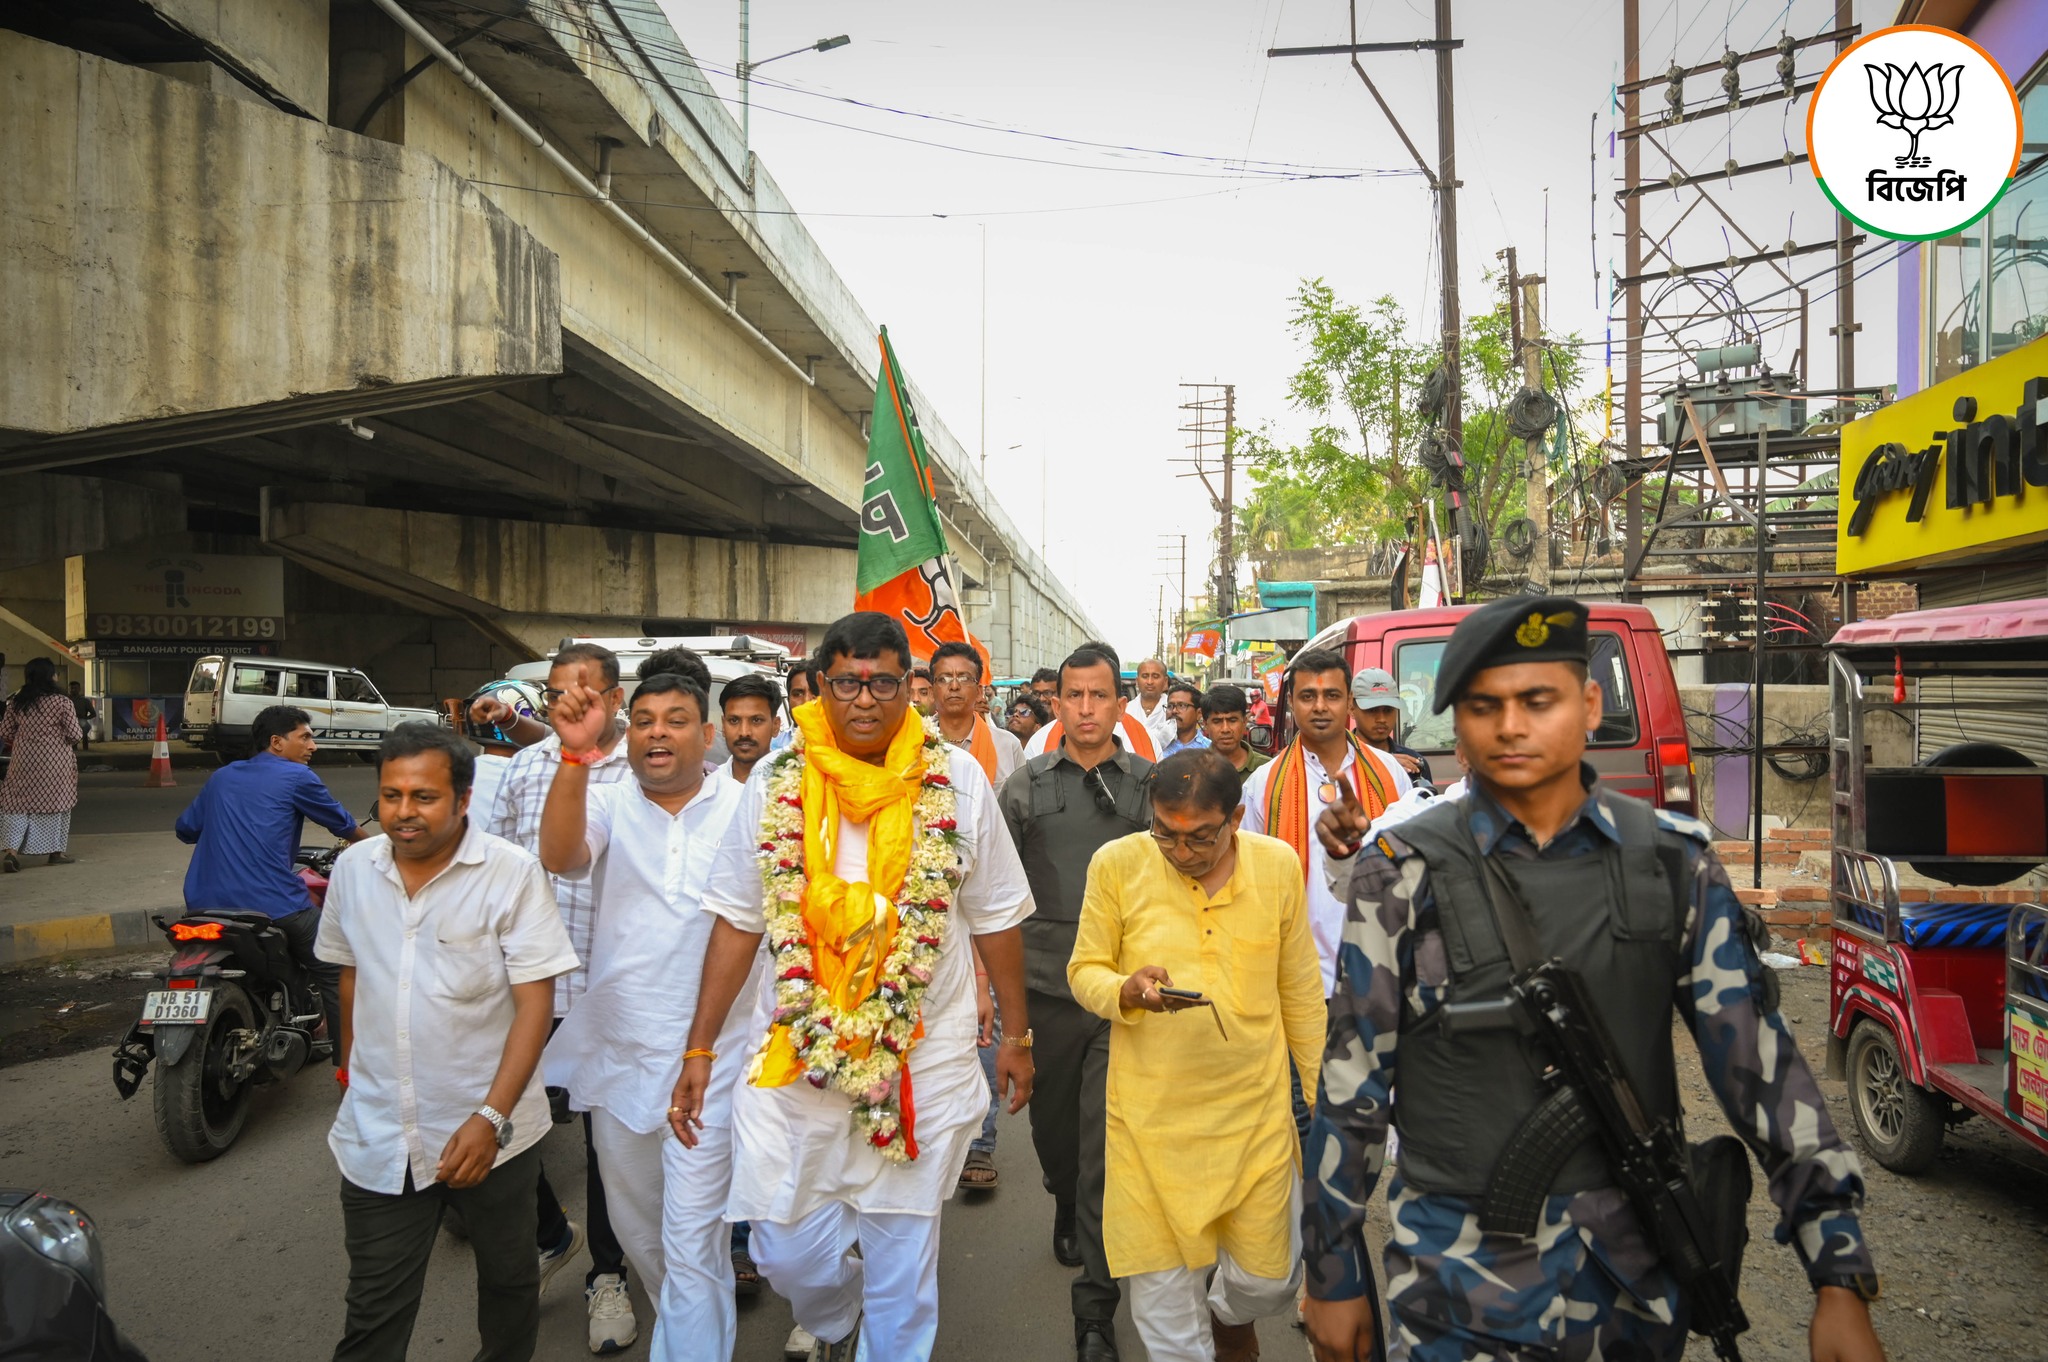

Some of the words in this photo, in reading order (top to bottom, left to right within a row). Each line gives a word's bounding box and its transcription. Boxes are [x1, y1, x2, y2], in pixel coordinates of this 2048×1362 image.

[96, 614, 276, 638] 9830012199
[123, 645, 178, 654] RANAGHAT
[180, 646, 211, 655] POLICE
[214, 646, 252, 655] DISTRICT
[160, 992, 177, 1005] WB
[184, 991, 201, 1005] 51
[154, 1005, 199, 1018] D1360
